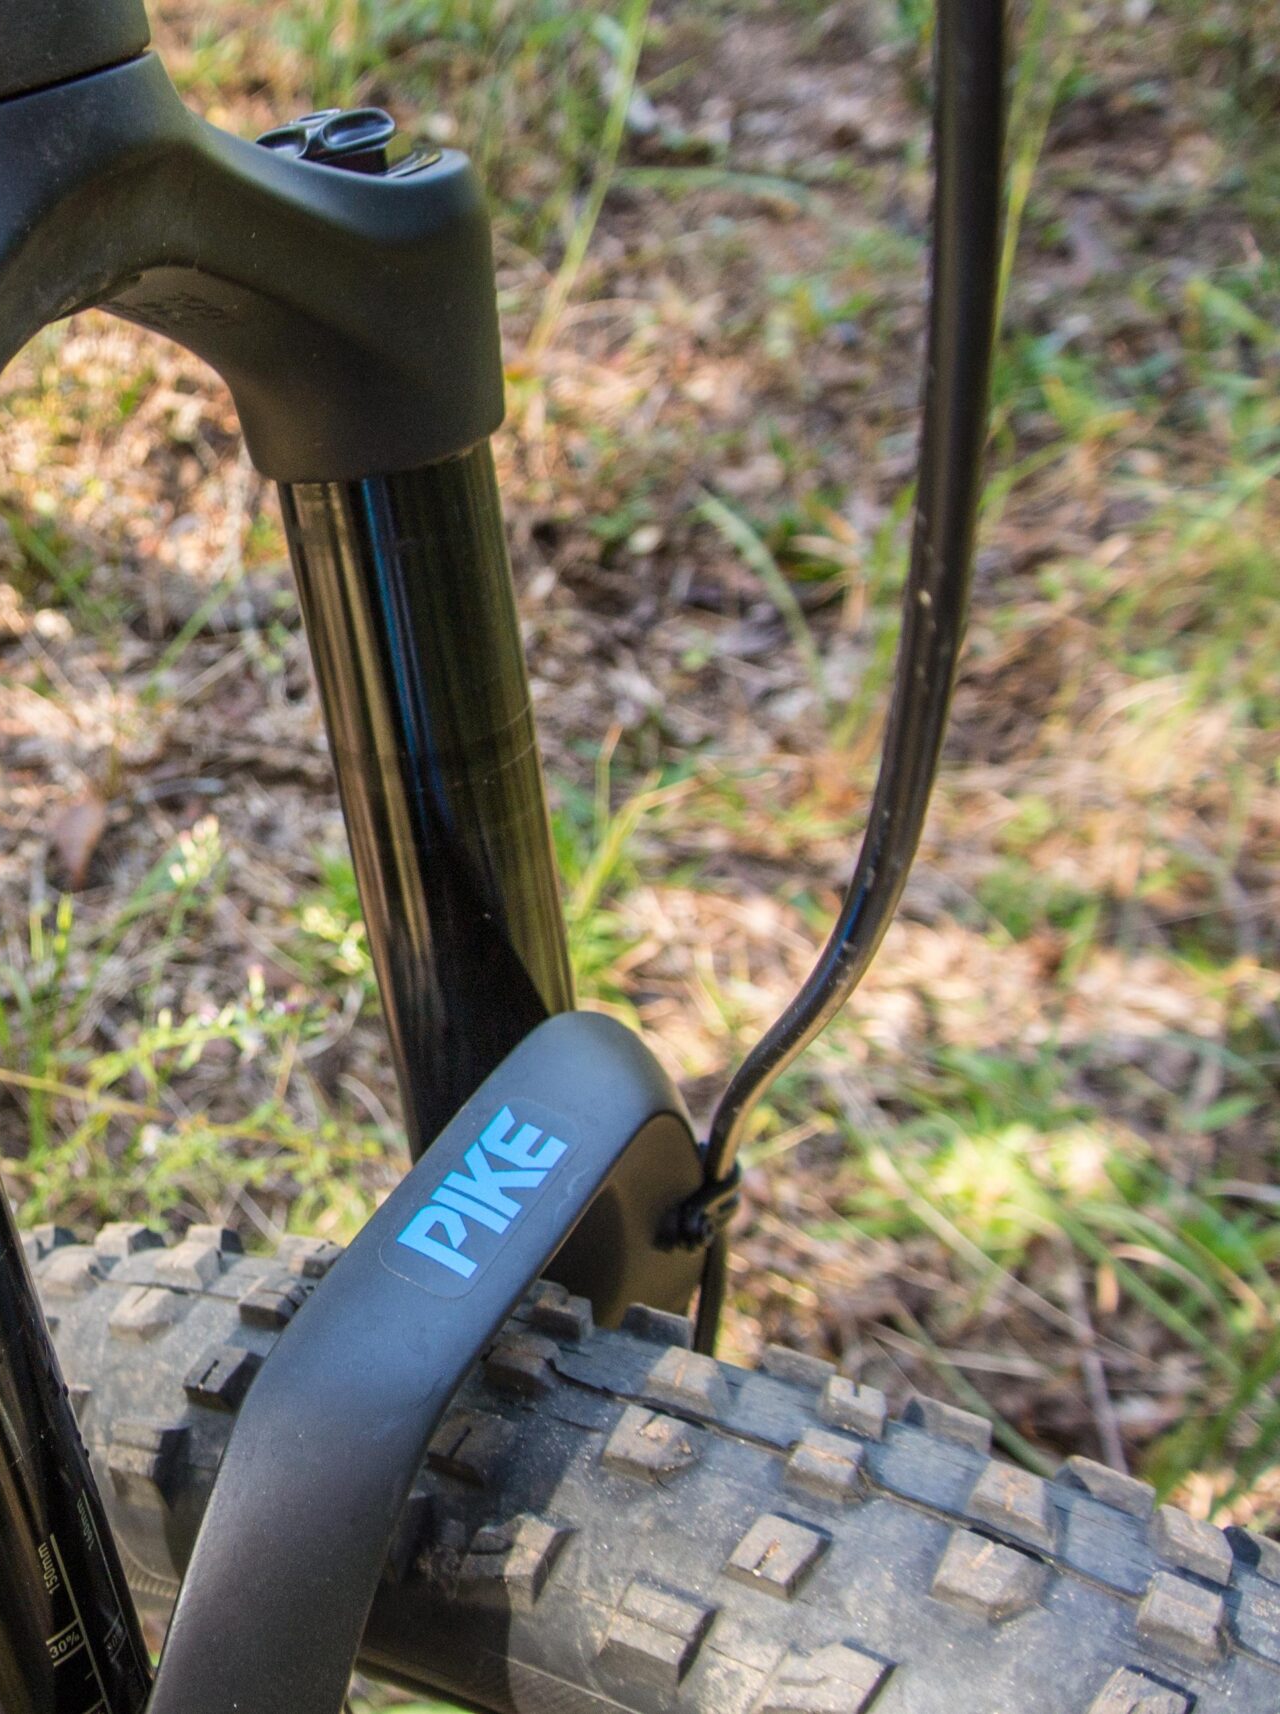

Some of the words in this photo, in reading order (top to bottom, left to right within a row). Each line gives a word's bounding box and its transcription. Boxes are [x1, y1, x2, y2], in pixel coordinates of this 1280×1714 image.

[396, 1104, 569, 1280] PIKE
[37, 1541, 60, 1594] 150mm
[49, 1631, 81, 1659] 30%
